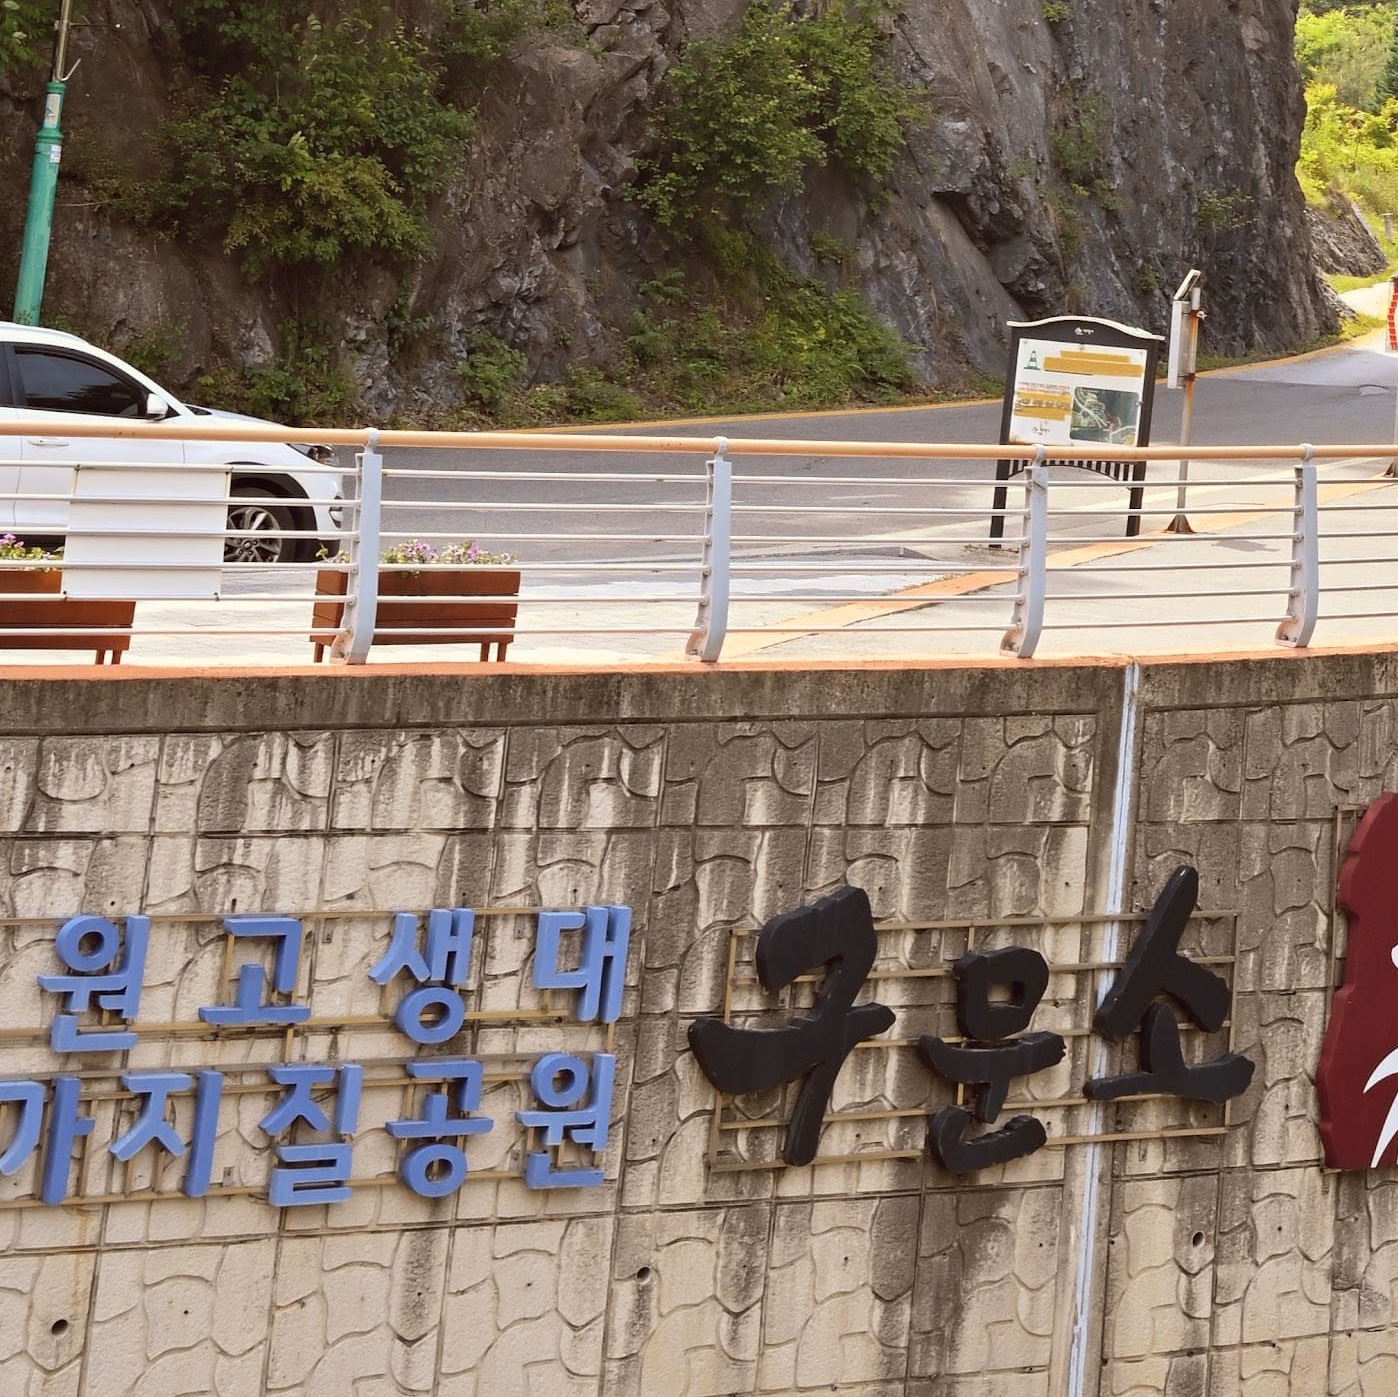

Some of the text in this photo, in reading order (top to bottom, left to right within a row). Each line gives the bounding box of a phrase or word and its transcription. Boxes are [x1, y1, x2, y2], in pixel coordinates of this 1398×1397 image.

[37, 905, 631, 1053] 원고생대
[687, 865, 1255, 1173] 구문소
[0, 1052, 616, 1206] 가지질공원
